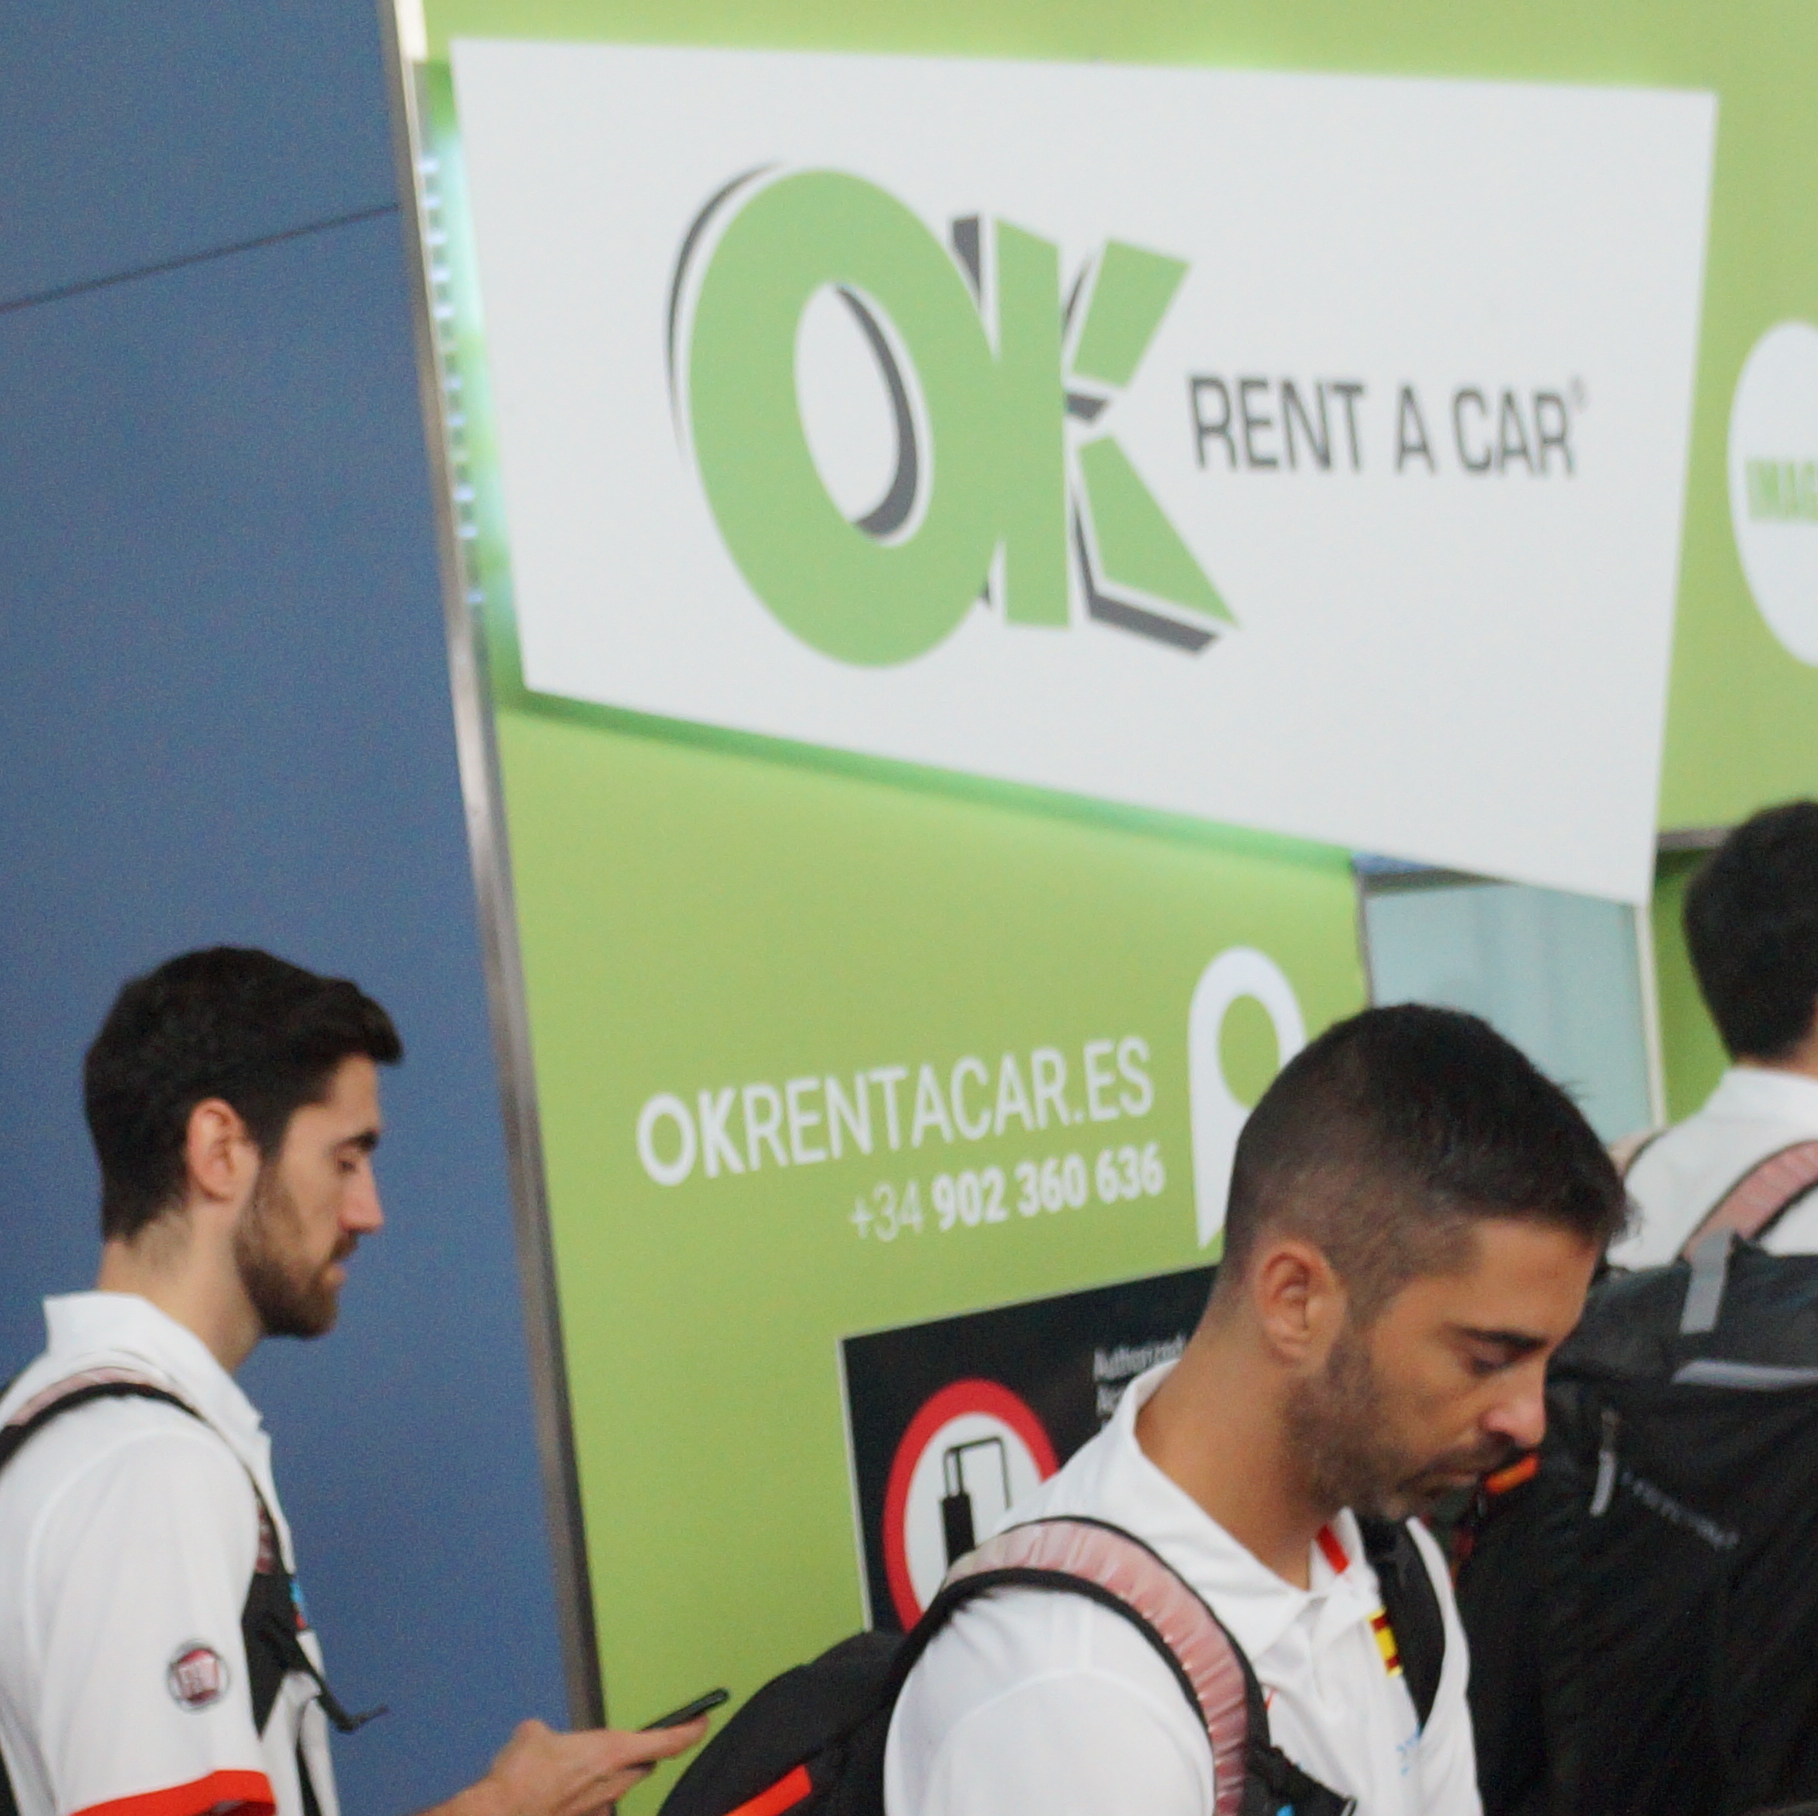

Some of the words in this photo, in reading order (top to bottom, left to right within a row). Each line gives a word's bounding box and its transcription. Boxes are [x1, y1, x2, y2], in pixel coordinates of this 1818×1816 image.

[669, 160, 1241, 668] OK
[1189, 373, 1367, 473] RENT
[1394, 380, 1437, 475] A
[636, 1036, 1155, 1187] OKRENTACAR.ES
[849, 1178, 924, 1243] +34
[932, 1166, 1007, 1233] 902
[1016, 1153, 1088, 1219] 360
[1095, 1141, 1166, 1202] 636
